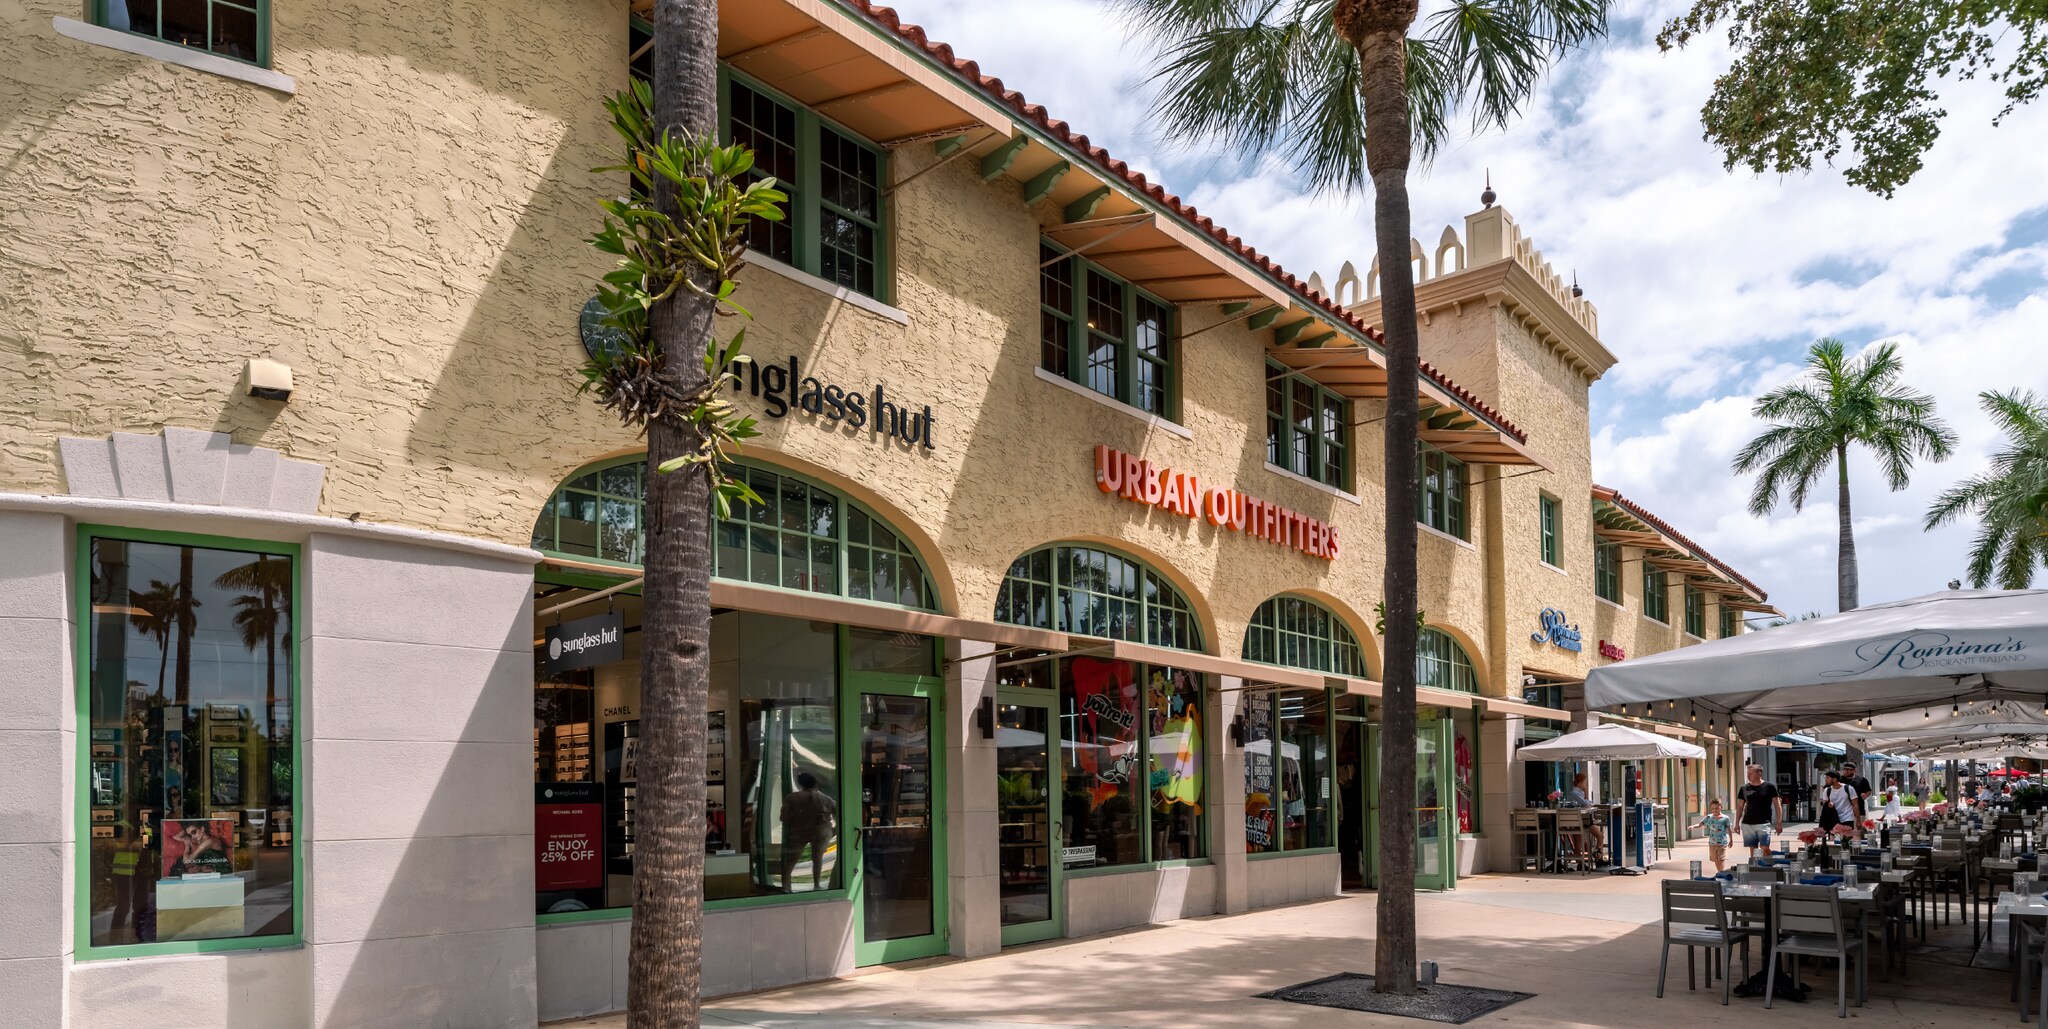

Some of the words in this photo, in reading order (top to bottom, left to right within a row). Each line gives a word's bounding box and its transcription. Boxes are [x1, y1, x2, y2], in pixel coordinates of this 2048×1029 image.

[720, 350, 867, 428] nglass
[876, 384, 936, 450] hut
[1095, 444, 1201, 519] URBAN
[1205, 484, 1341, 561] OUTFITTERS
[563, 632, 601, 654] sunglass
[601, 626, 618, 645] hut
[1818, 632, 2027, 677] Romina's
[1923, 657, 1976, 668] RISTORANTE
[1978, 654, 2027, 664] ITALIANO
[604, 705, 631, 717] CHANEL
[548, 840, 589, 851] ENJOY
[1068, 846, 1095, 855] TRESPASSING
[541, 851, 567, 863] 25%
[570, 850, 594, 861] OFF
